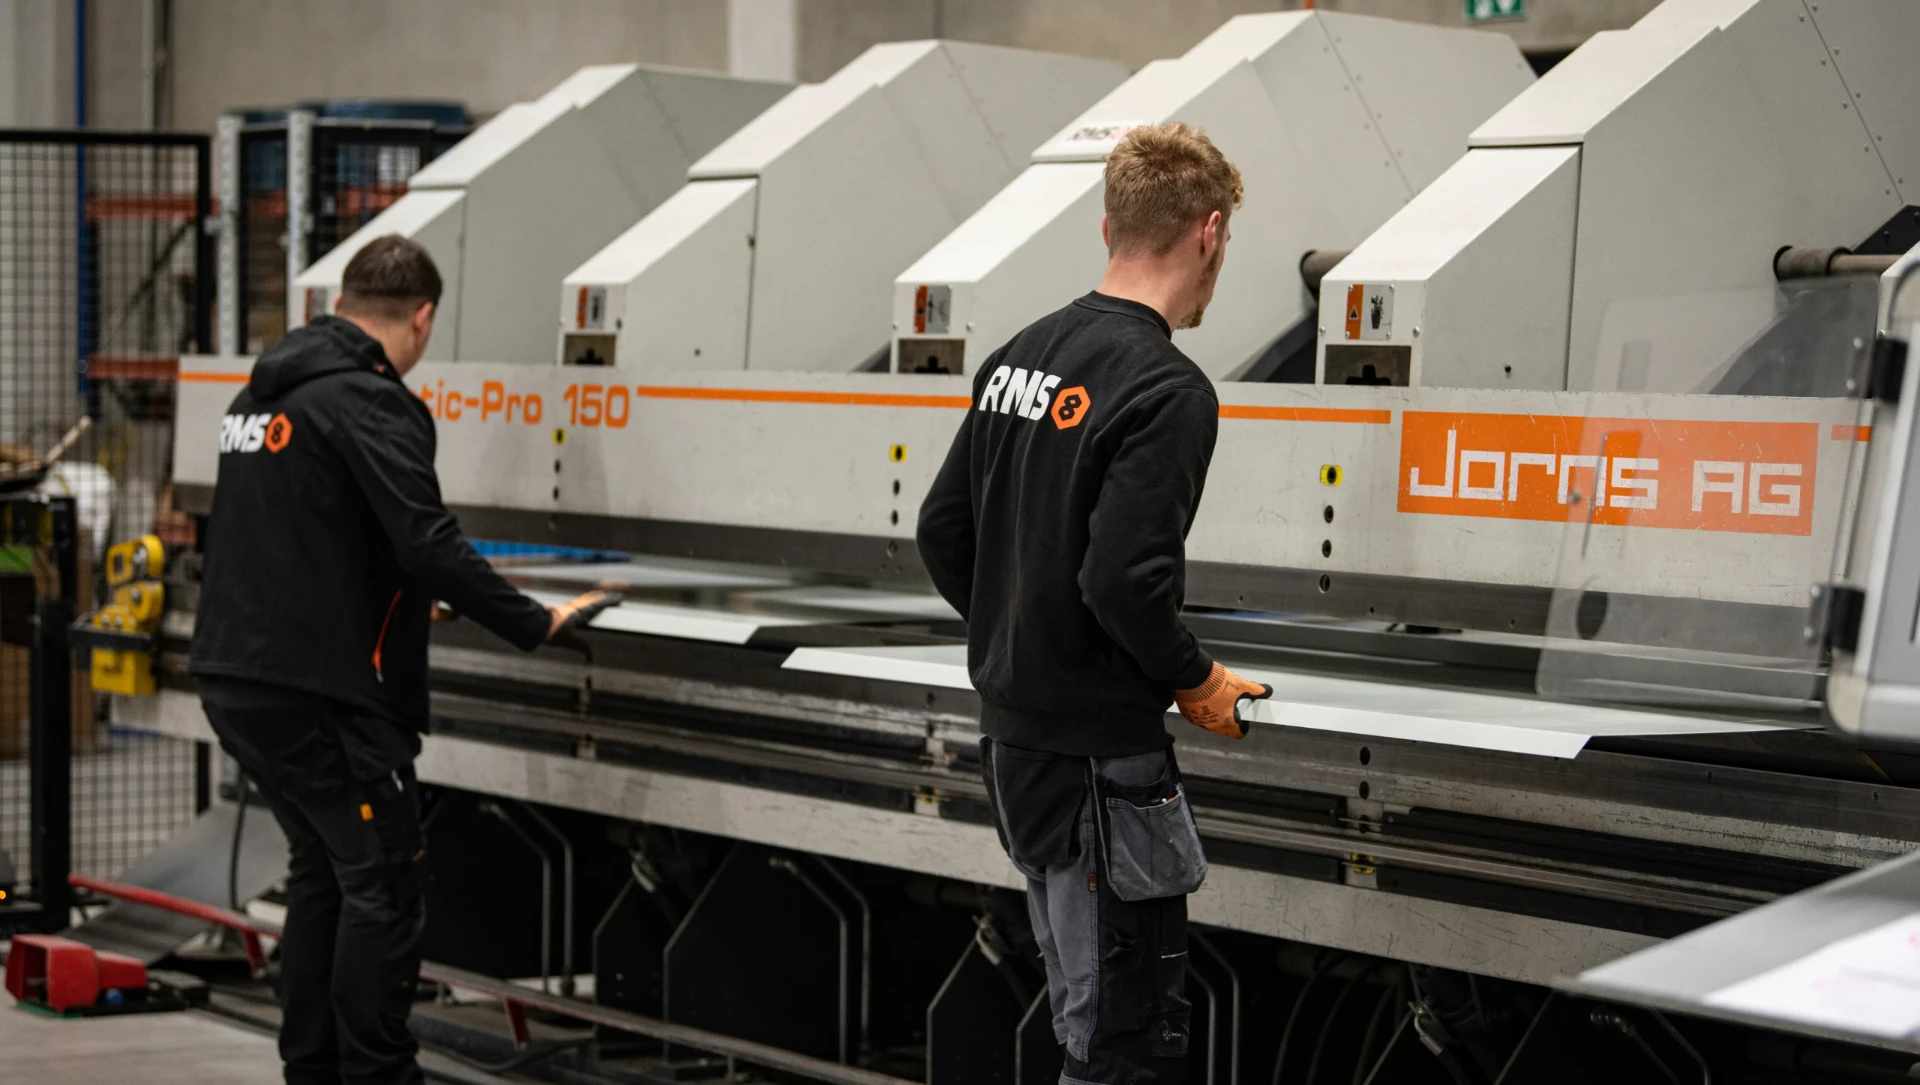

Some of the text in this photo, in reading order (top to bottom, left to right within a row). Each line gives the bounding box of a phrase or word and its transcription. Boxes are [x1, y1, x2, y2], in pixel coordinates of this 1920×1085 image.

[411, 378, 630, 429] tic-Pro 150
[1410, 429, 1802, 517] Jorns AG
